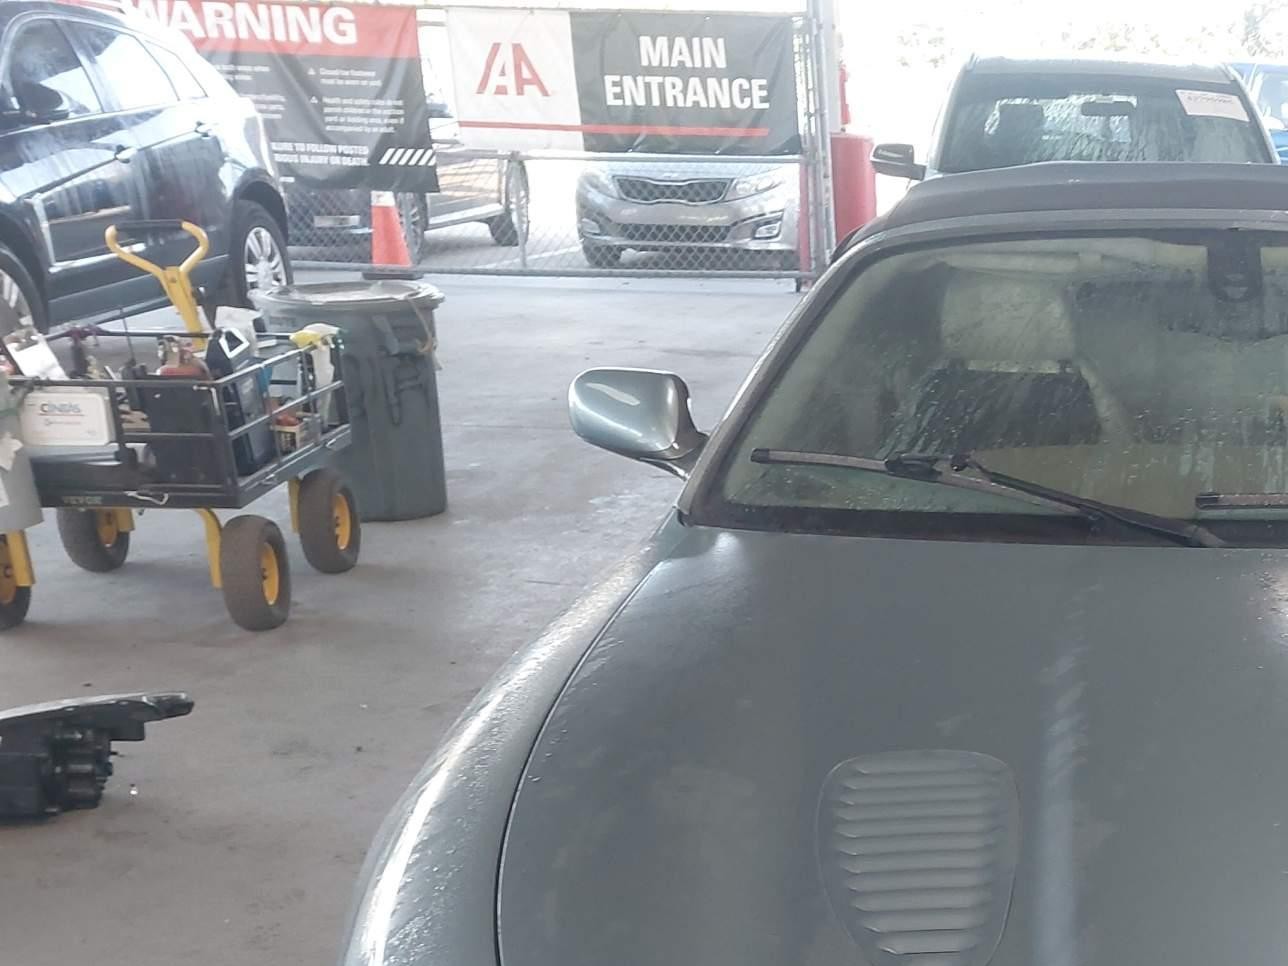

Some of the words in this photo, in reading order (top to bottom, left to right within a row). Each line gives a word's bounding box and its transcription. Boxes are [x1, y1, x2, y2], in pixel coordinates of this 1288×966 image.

[128, 0, 358, 44] WARNING
[638, 35, 727, 69] MAIN
[604, 74, 770, 109] ENTRANCE
